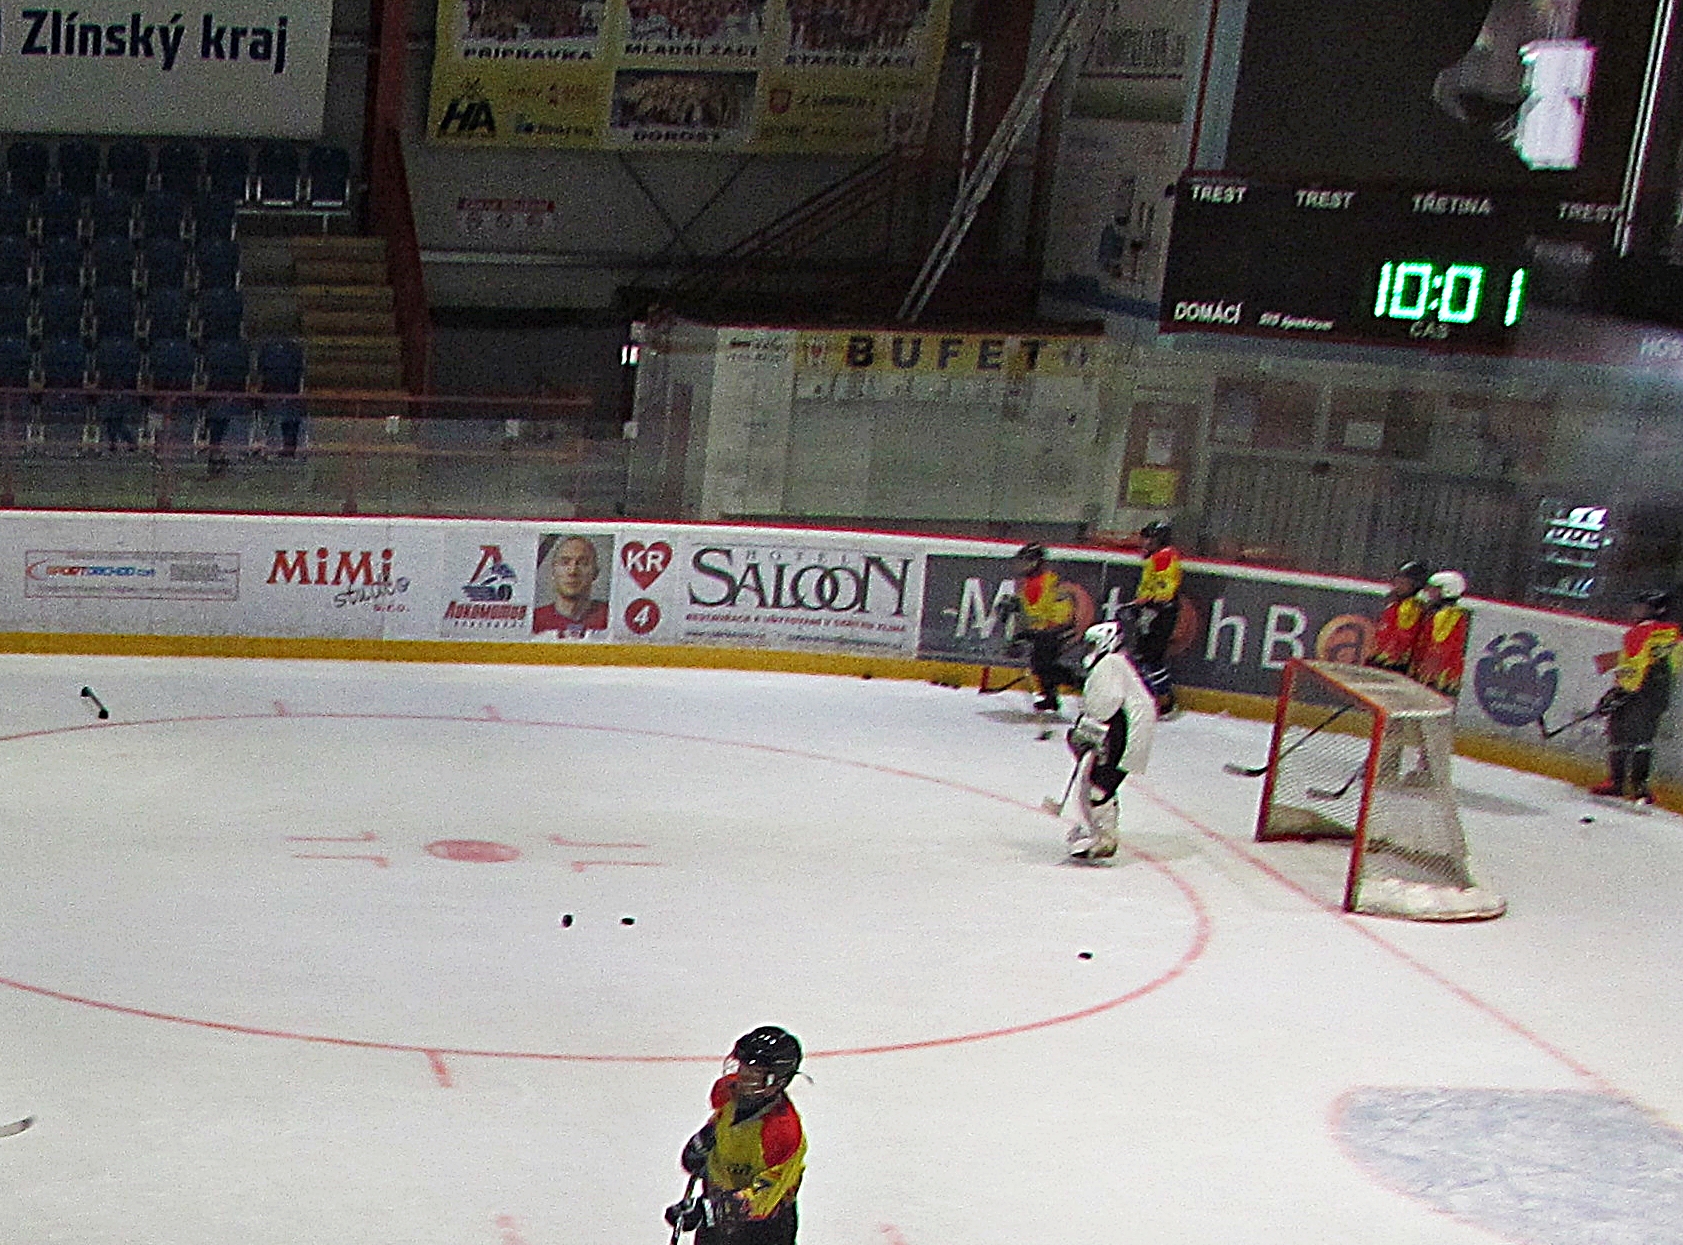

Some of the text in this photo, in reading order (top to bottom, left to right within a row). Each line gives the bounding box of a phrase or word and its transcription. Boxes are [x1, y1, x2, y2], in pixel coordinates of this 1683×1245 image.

[21, 9, 289, 74] Zlínský kraj
[1189, 183, 1248, 204] TREST
[1294, 188, 1356, 211] TREST
[1374, 260, 1529, 328] 10:01
[1172, 300, 1243, 325] DOMÁCÍ
[845, 335, 1048, 373] BUFET
[266, 547, 394, 587] MiMi
[624, 549, 665, 573] KR
[746, 550, 850, 565] HOTEL
[688, 546, 914, 617] SALOON
[632, 606, 651, 628] 4
